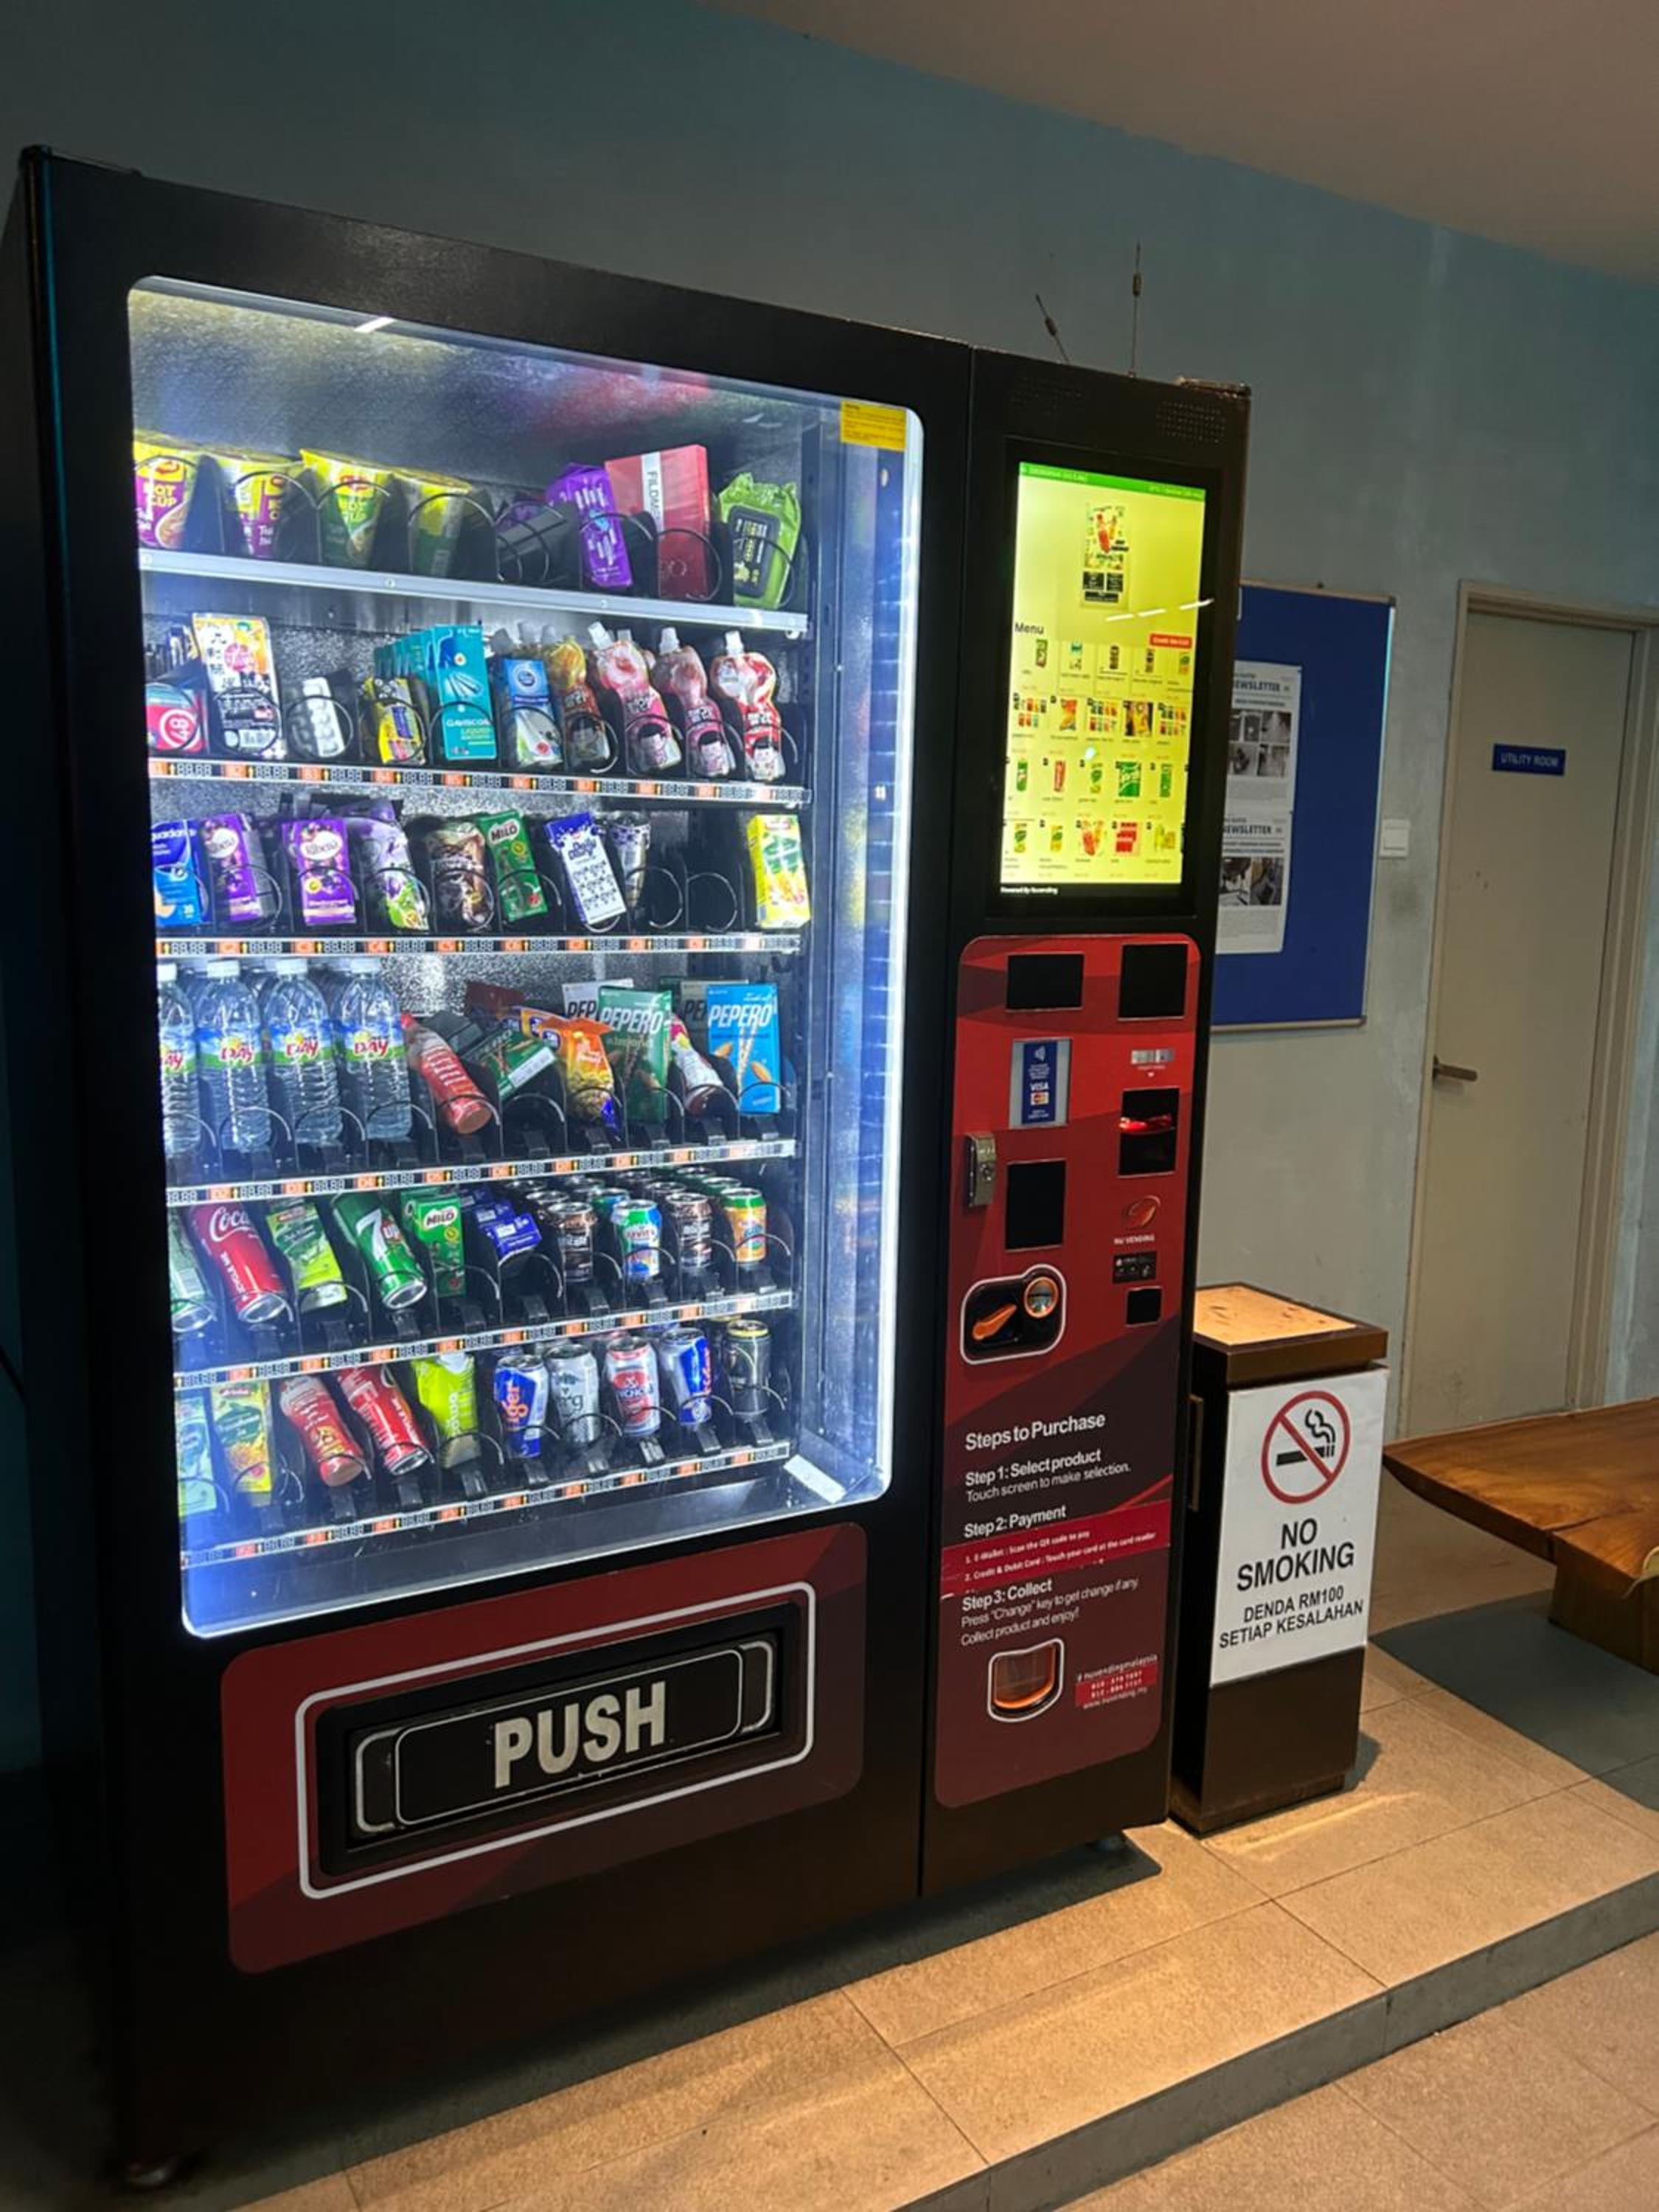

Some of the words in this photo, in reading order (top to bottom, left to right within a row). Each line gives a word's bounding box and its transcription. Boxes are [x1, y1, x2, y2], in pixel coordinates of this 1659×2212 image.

[1015, 623, 1044, 635] Menu
[1500, 752, 1532, 765] UTILITY
[1534, 755, 1559, 767] ROOM
[491, 824, 518, 841] MILO
[600, 1006, 664, 1034] PEPERO
[708, 1004, 773, 1028] PEPERO
[426, 1210, 455, 1226] MILO
[965, 1427, 1012, 1451] Steps
[1013, 1426, 1030, 1442] to
[1032, 1413, 1106, 1439] Purchase
[965, 1469, 995, 1487] Step
[998, 1464, 1009, 1480] 1:
[1010, 1457, 1050, 1477] Select
[1051, 1448, 1102, 1472] product
[966, 1484, 1000, 1503] Touch
[1001, 1478, 1039, 1498] screen
[1040, 1475, 1051, 1489] to
[1051, 1472, 1082, 1486] make
[1083, 1461, 1132, 1480] selection.
[964, 1520, 995, 1539] Step
[995, 1516, 1008, 1531] 2:
[1009, 1504, 1067, 1529] Payment
[1281, 1517, 1318, 1550] NO
[973, 1568, 996, 1580] Credit
[997, 1565, 1003, 1574] &
[1004, 1562, 1024, 1573] Debit
[1024, 1557, 1041, 1568] Card
[1046, 1551, 1066, 1562] Touch
[1083, 1544, 1099, 1555] card
[1107, 1540, 1119, 1549] the
[1119, 1536, 1134, 1546] card
[1237, 1541, 1355, 1592] SMOKING
[961, 1612, 990, 1628] Press
[1036, 1596, 1053, 1611] key
[1054, 1593, 1065, 1605] to
[1065, 1590, 1081, 1604] get
[1081, 1582, 1113, 1601] change
[962, 1593, 992, 1612] Step
[993, 1589, 1006, 1604] 3:
[1007, 1578, 1052, 1600] Collect
[1244, 1598, 1295, 1623] DENDA
[1298, 1585, 1344, 1609] RM100
[961, 1628, 994, 1646] Collect
[995, 1619, 1031, 1639] product
[1032, 1613, 1051, 1629] and
[1051, 1607, 1080, 1625] enjoy!
[1219, 1621, 1273, 1649] SETIAP
[1276, 1599, 1364, 1635] KESALAHAN
[493, 1680, 667, 1790] PUSH
